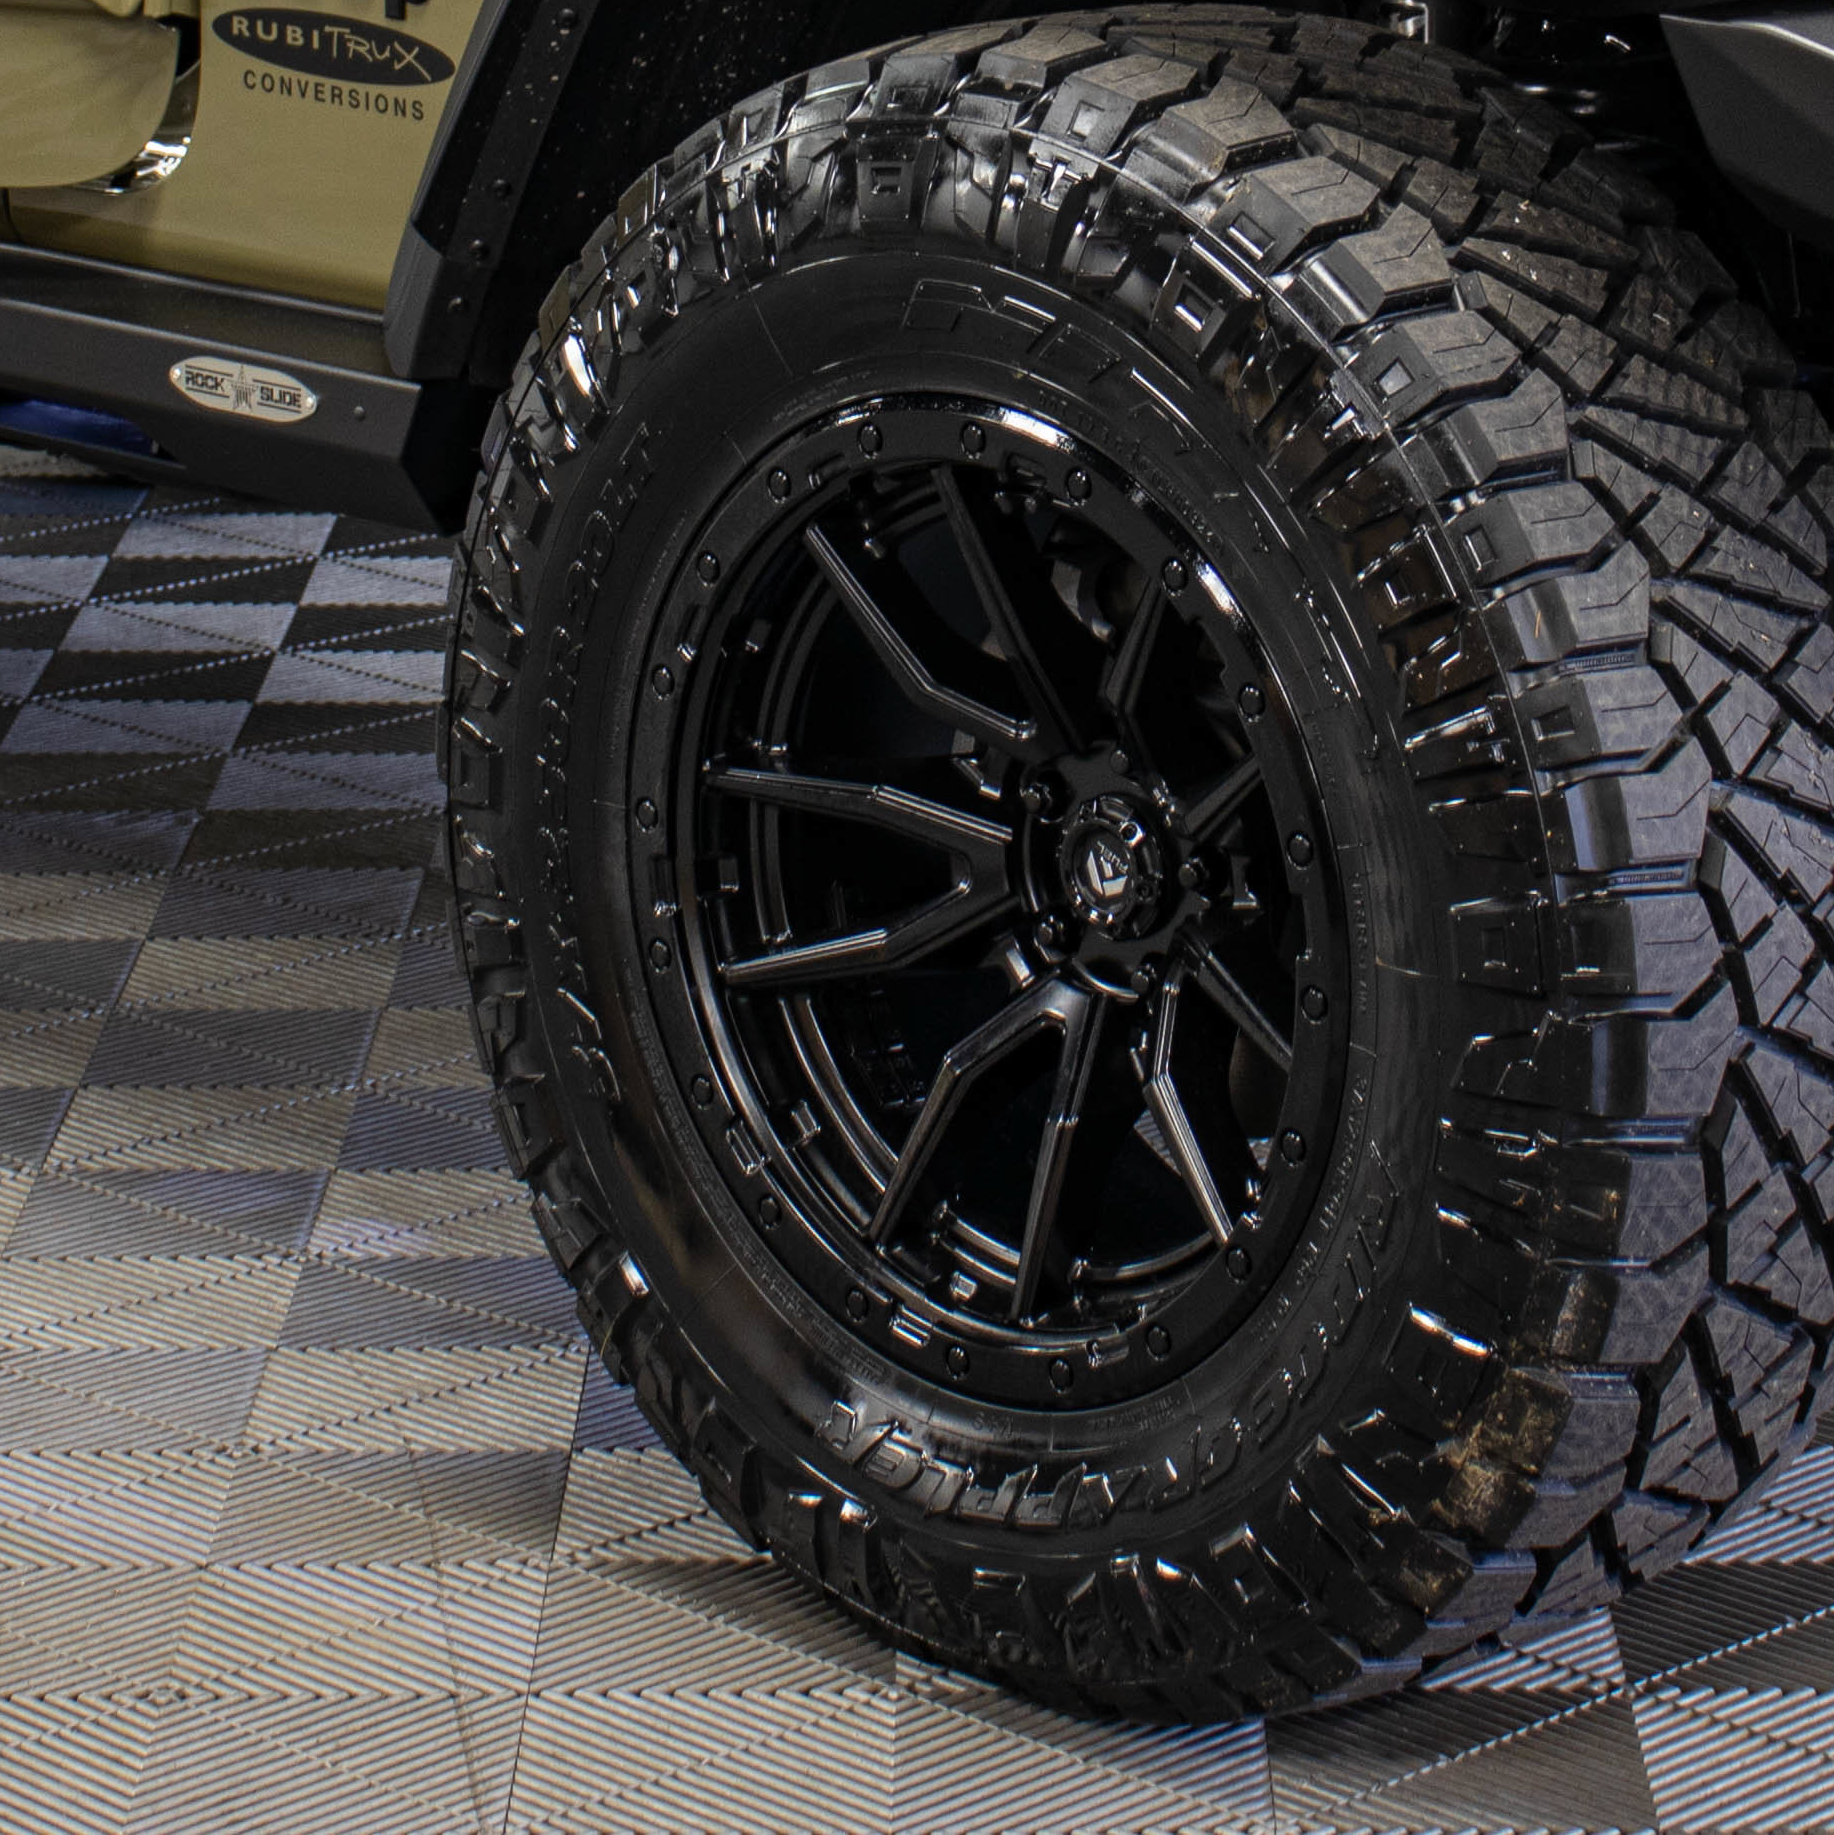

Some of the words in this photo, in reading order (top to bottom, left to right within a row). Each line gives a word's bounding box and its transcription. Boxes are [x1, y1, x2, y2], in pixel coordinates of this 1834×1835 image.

[243, 69, 425, 121] CONVERSIONS
[185, 369, 226, 392] ROCK
[260, 385, 302, 409] SLIDE
